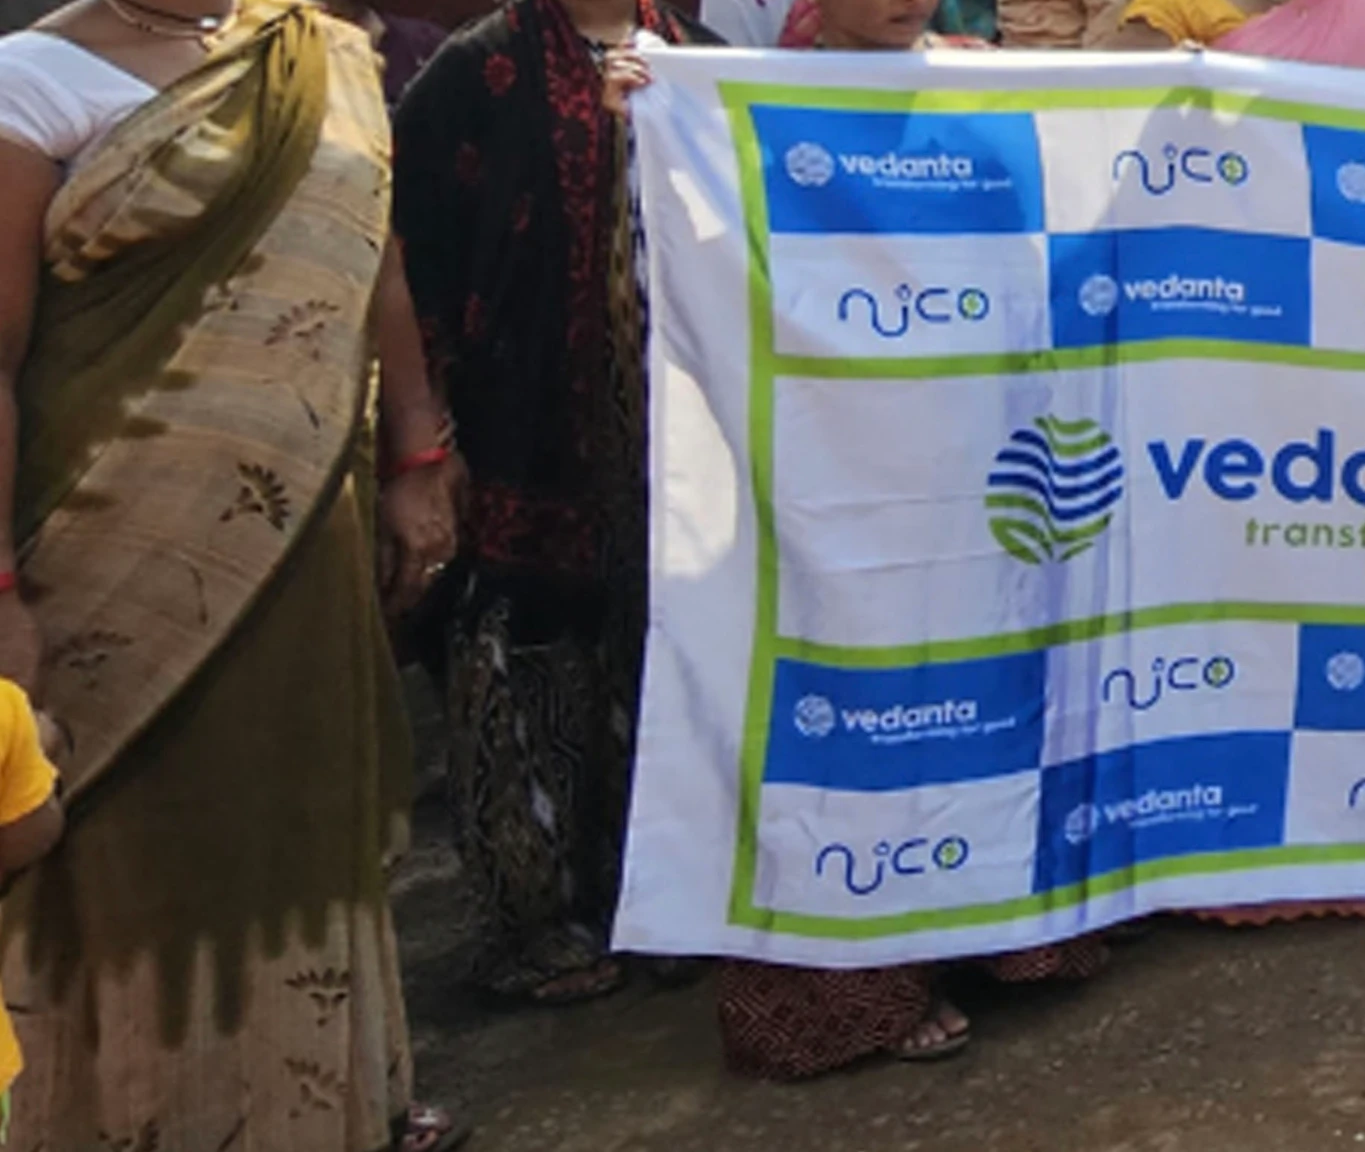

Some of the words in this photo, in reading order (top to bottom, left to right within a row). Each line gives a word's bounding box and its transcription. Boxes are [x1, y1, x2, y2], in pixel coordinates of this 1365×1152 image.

[838, 152, 973, 177] vedanta
[1123, 273, 1245, 301] vedanta
[842, 700, 977, 732] vedanta
[1104, 784, 1222, 823] vedanta
